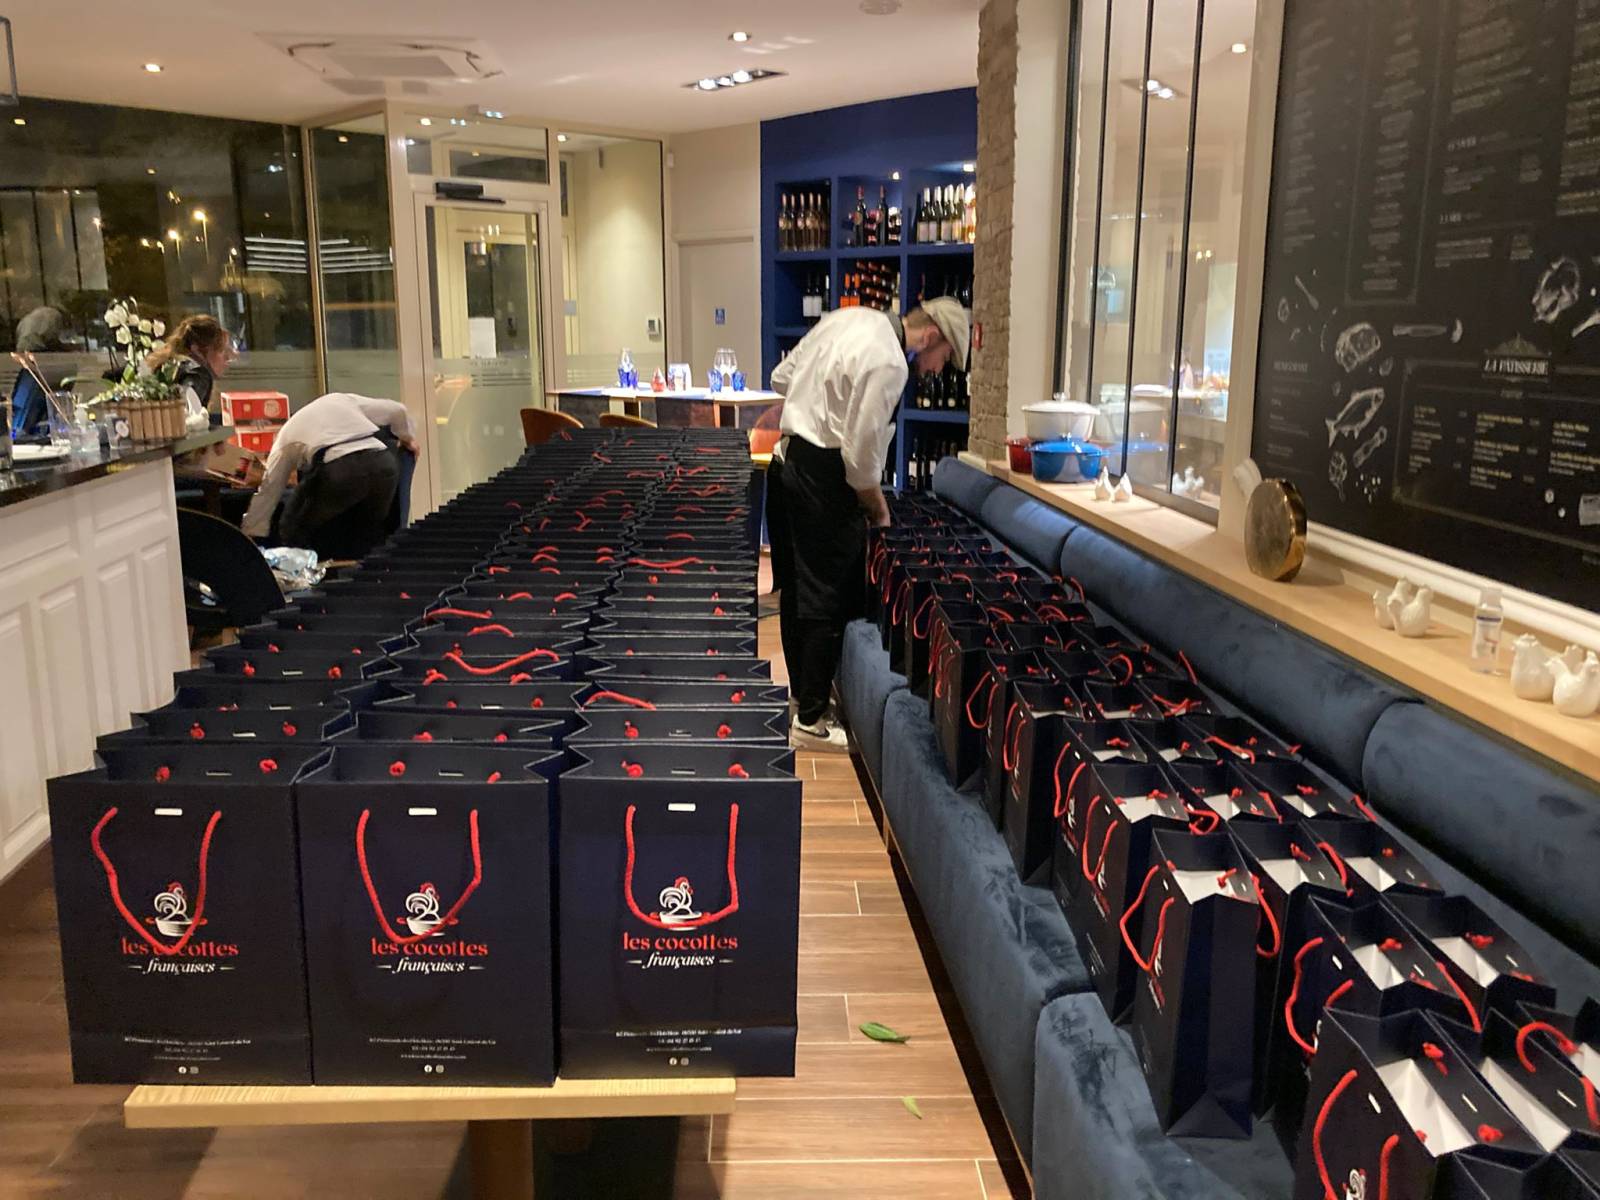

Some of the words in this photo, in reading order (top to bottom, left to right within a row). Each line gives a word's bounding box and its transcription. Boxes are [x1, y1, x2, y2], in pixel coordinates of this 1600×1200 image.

[121, 936, 149, 955] les
[153, 941, 239, 957] ccottes
[371, 937, 400, 955] les
[403, 941, 488, 956] cocottes
[621, 931, 651, 950] les
[655, 934, 738, 950] cocottes
[142, 957, 216, 975] françaises
[391, 956, 465, 975] françaises
[641, 951, 715, 969] françaises
